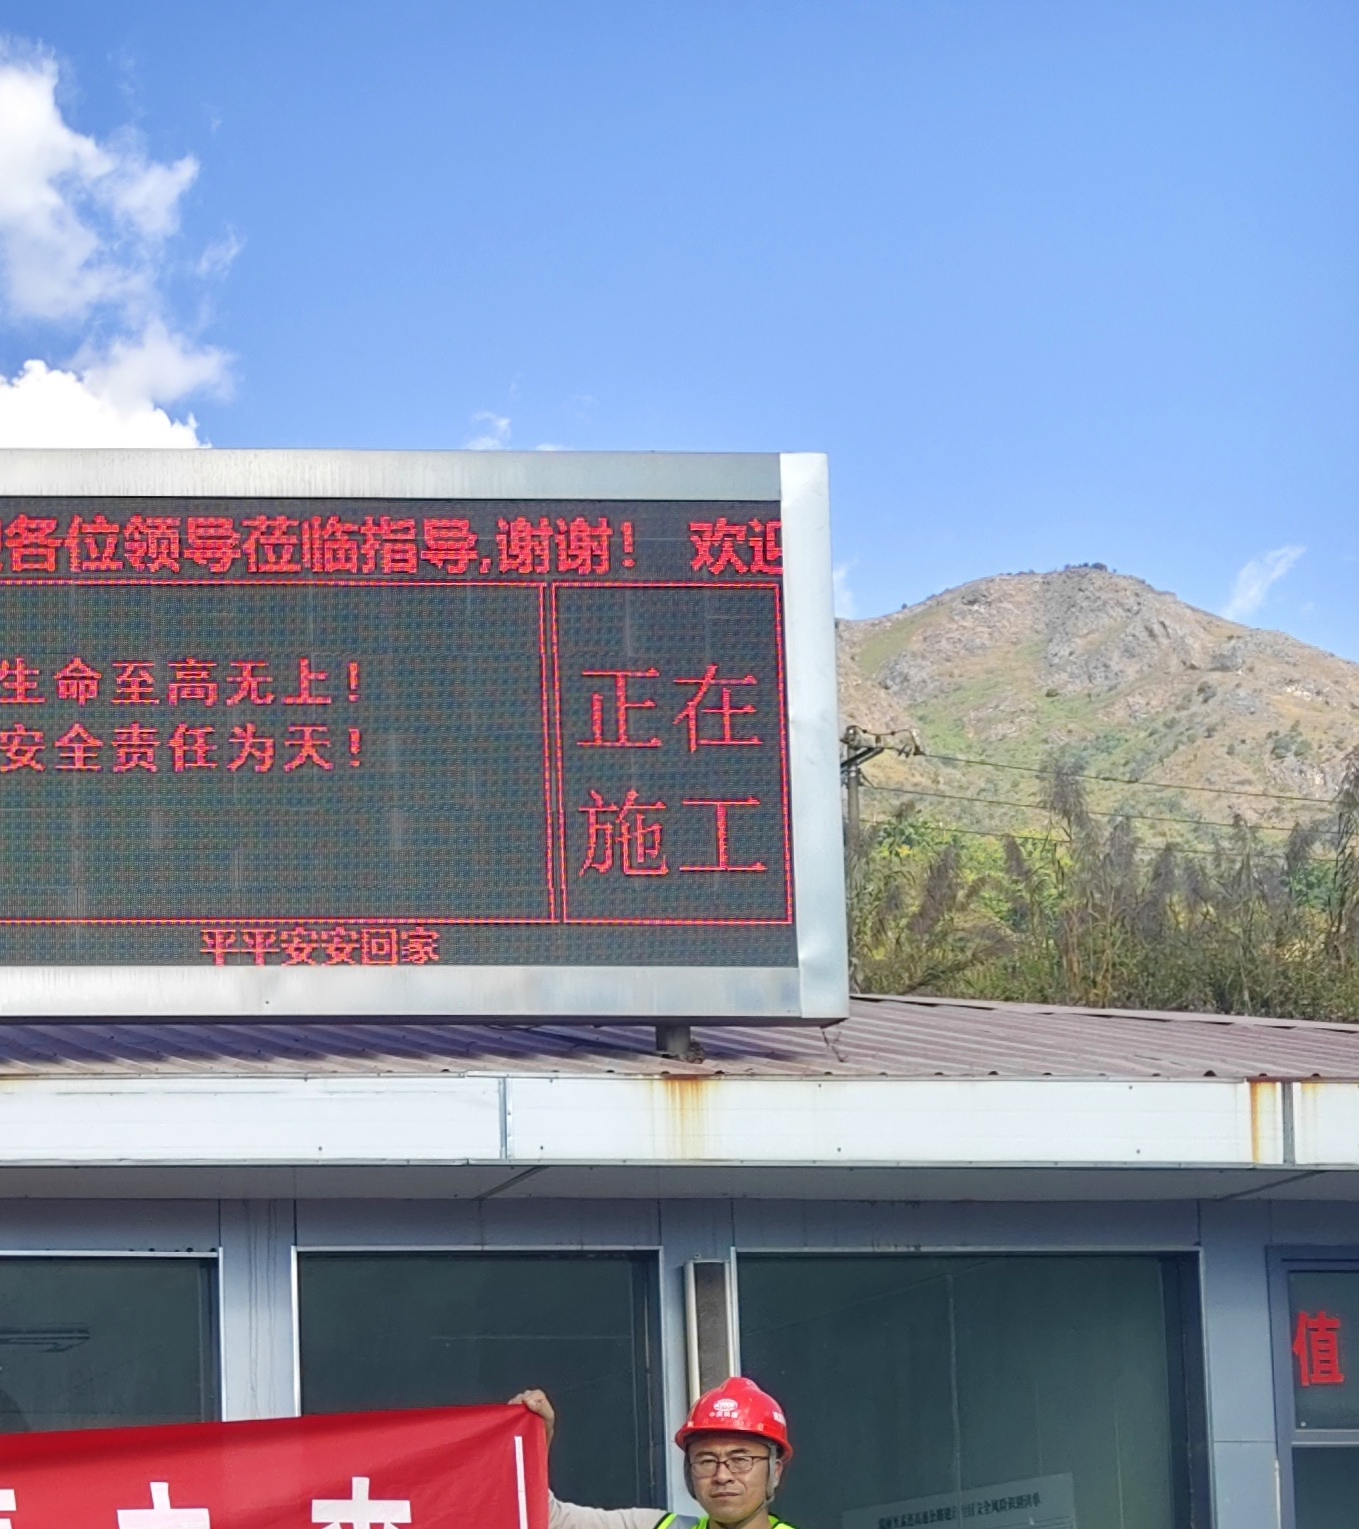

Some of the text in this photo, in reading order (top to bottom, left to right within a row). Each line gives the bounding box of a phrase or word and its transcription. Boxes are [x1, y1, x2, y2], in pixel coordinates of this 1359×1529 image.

[577, 663, 764, 754] 正在
[577, 788, 768, 878] 施工
[200, 926, 440, 967] 平平安安回家
[1293, 1311, 1345, 1387] 值
